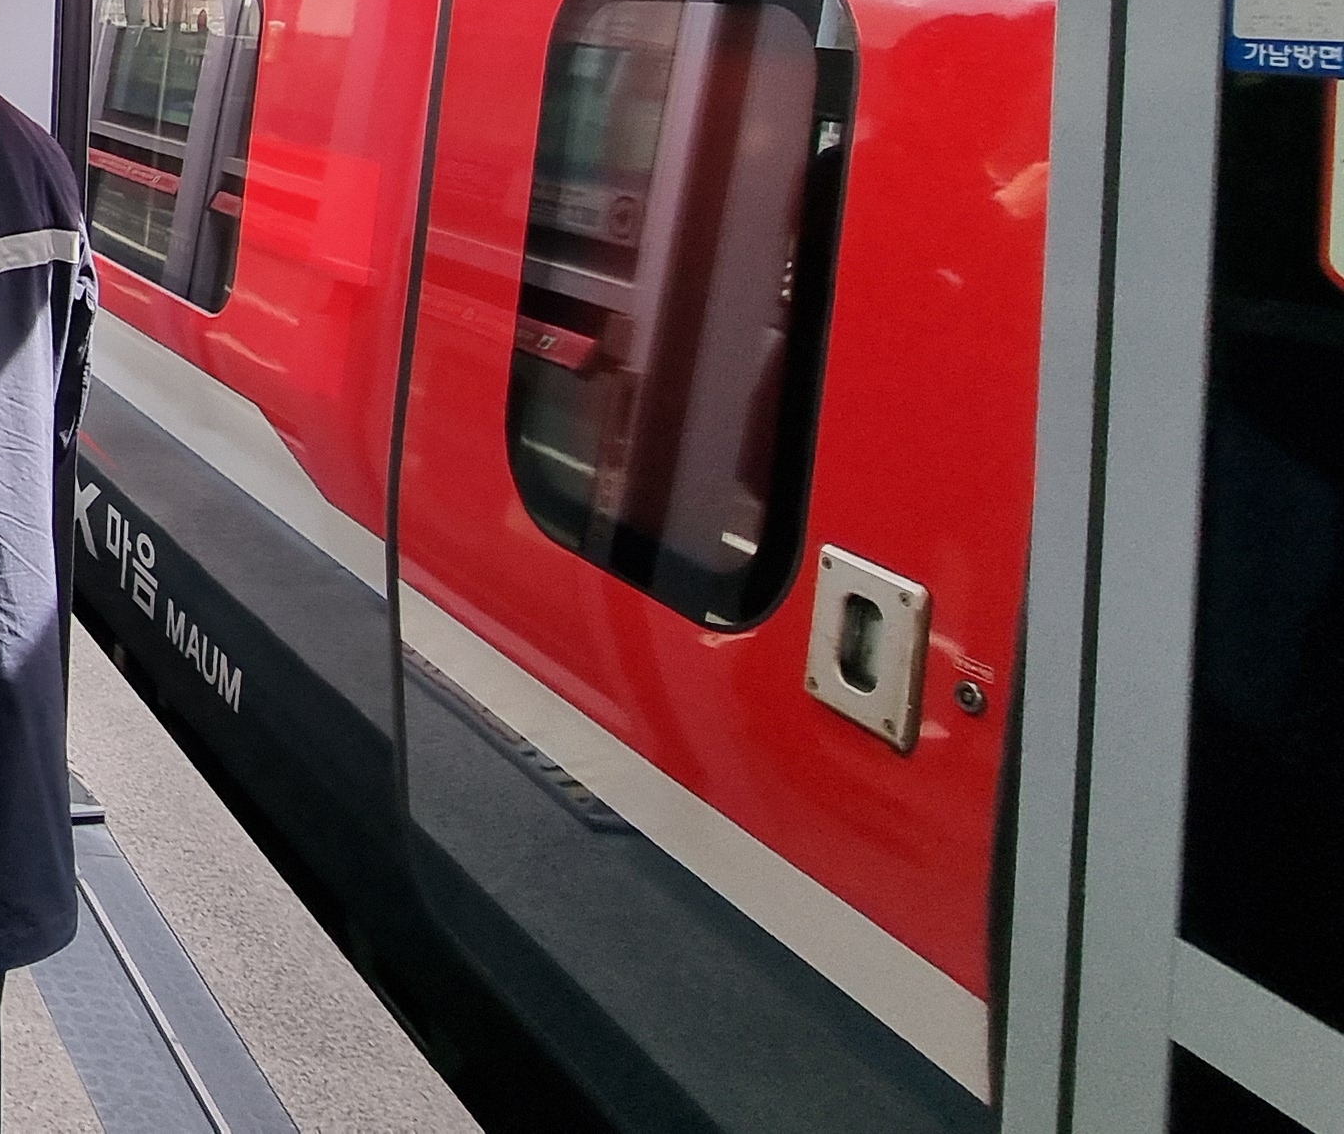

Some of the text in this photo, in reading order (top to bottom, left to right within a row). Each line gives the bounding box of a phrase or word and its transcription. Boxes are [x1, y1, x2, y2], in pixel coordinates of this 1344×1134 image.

[1244, 43, 1344, 70] 가남방면
[106, 503, 243, 714] 마음 MAUM
